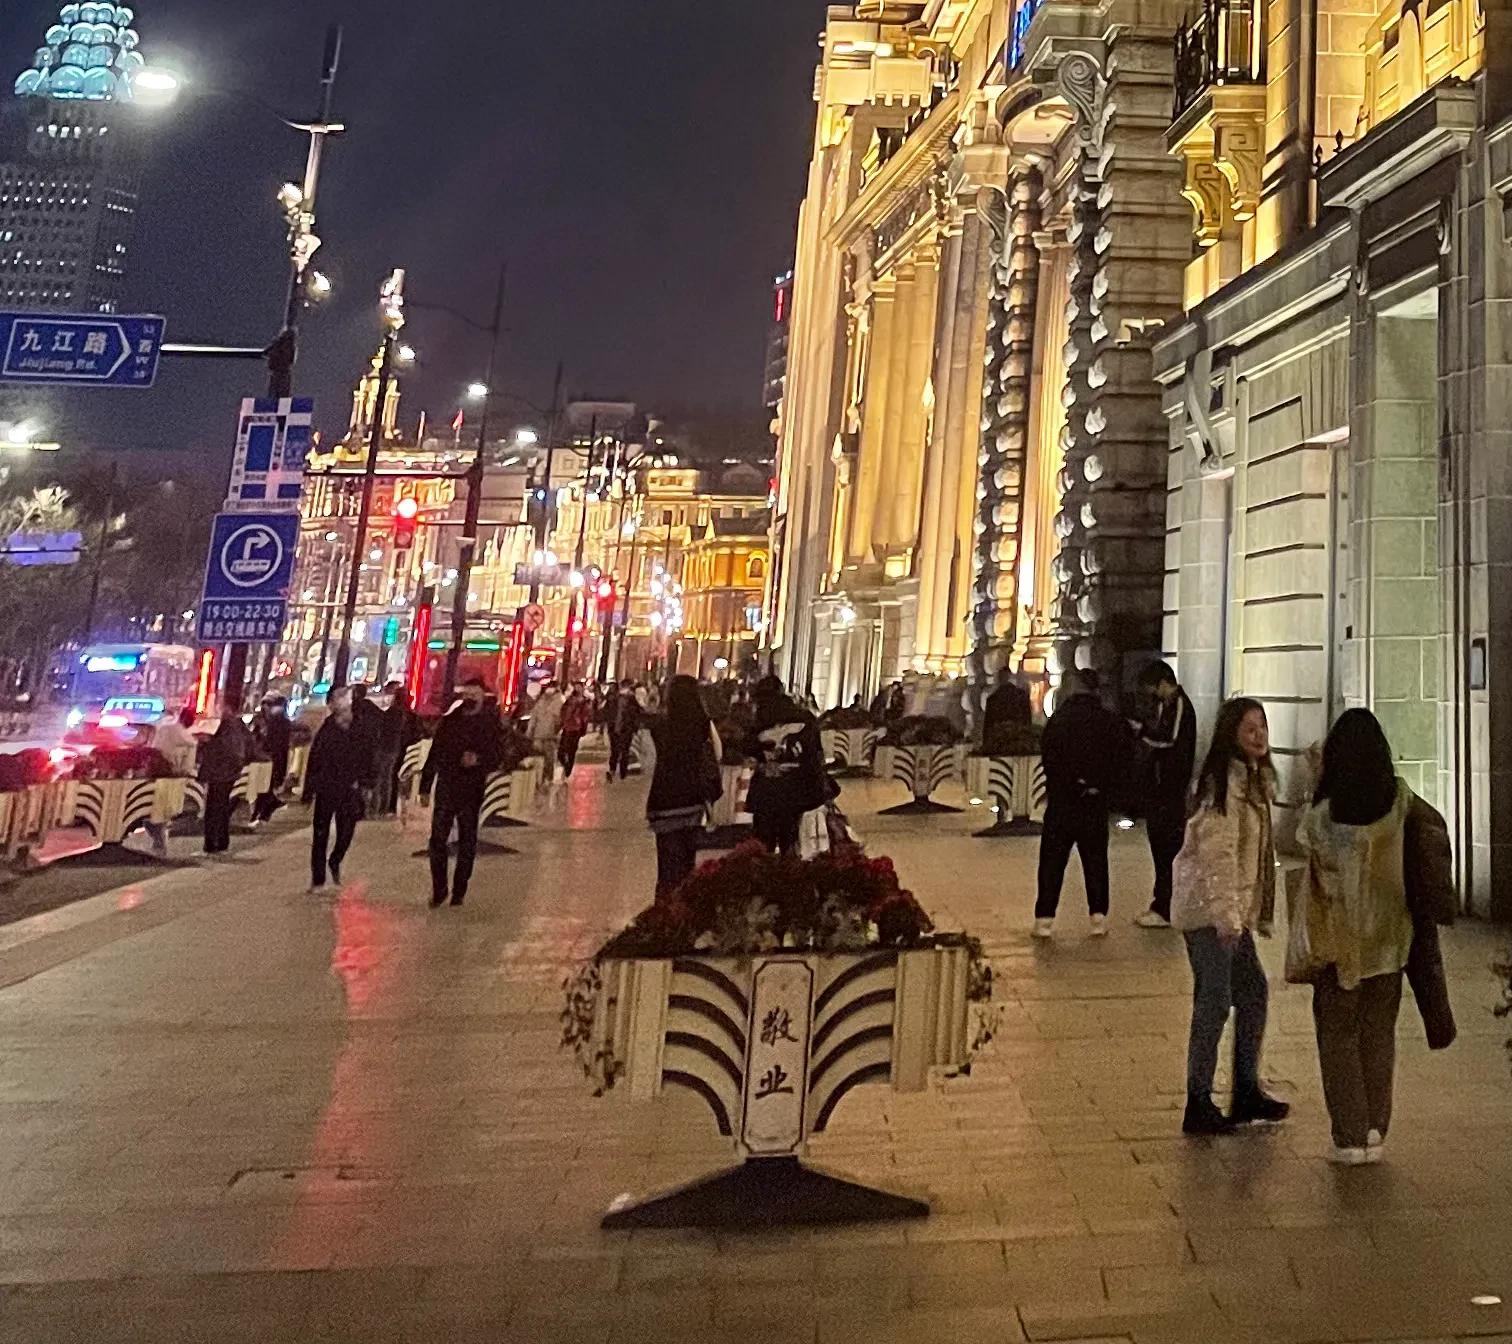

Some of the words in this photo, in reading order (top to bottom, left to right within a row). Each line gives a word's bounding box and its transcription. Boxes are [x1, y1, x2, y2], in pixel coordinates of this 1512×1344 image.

[20, 328, 108, 355] 九江路
[18, 358, 74, 372] Jiujiang
[755, 1005, 799, 1100] 敬业
